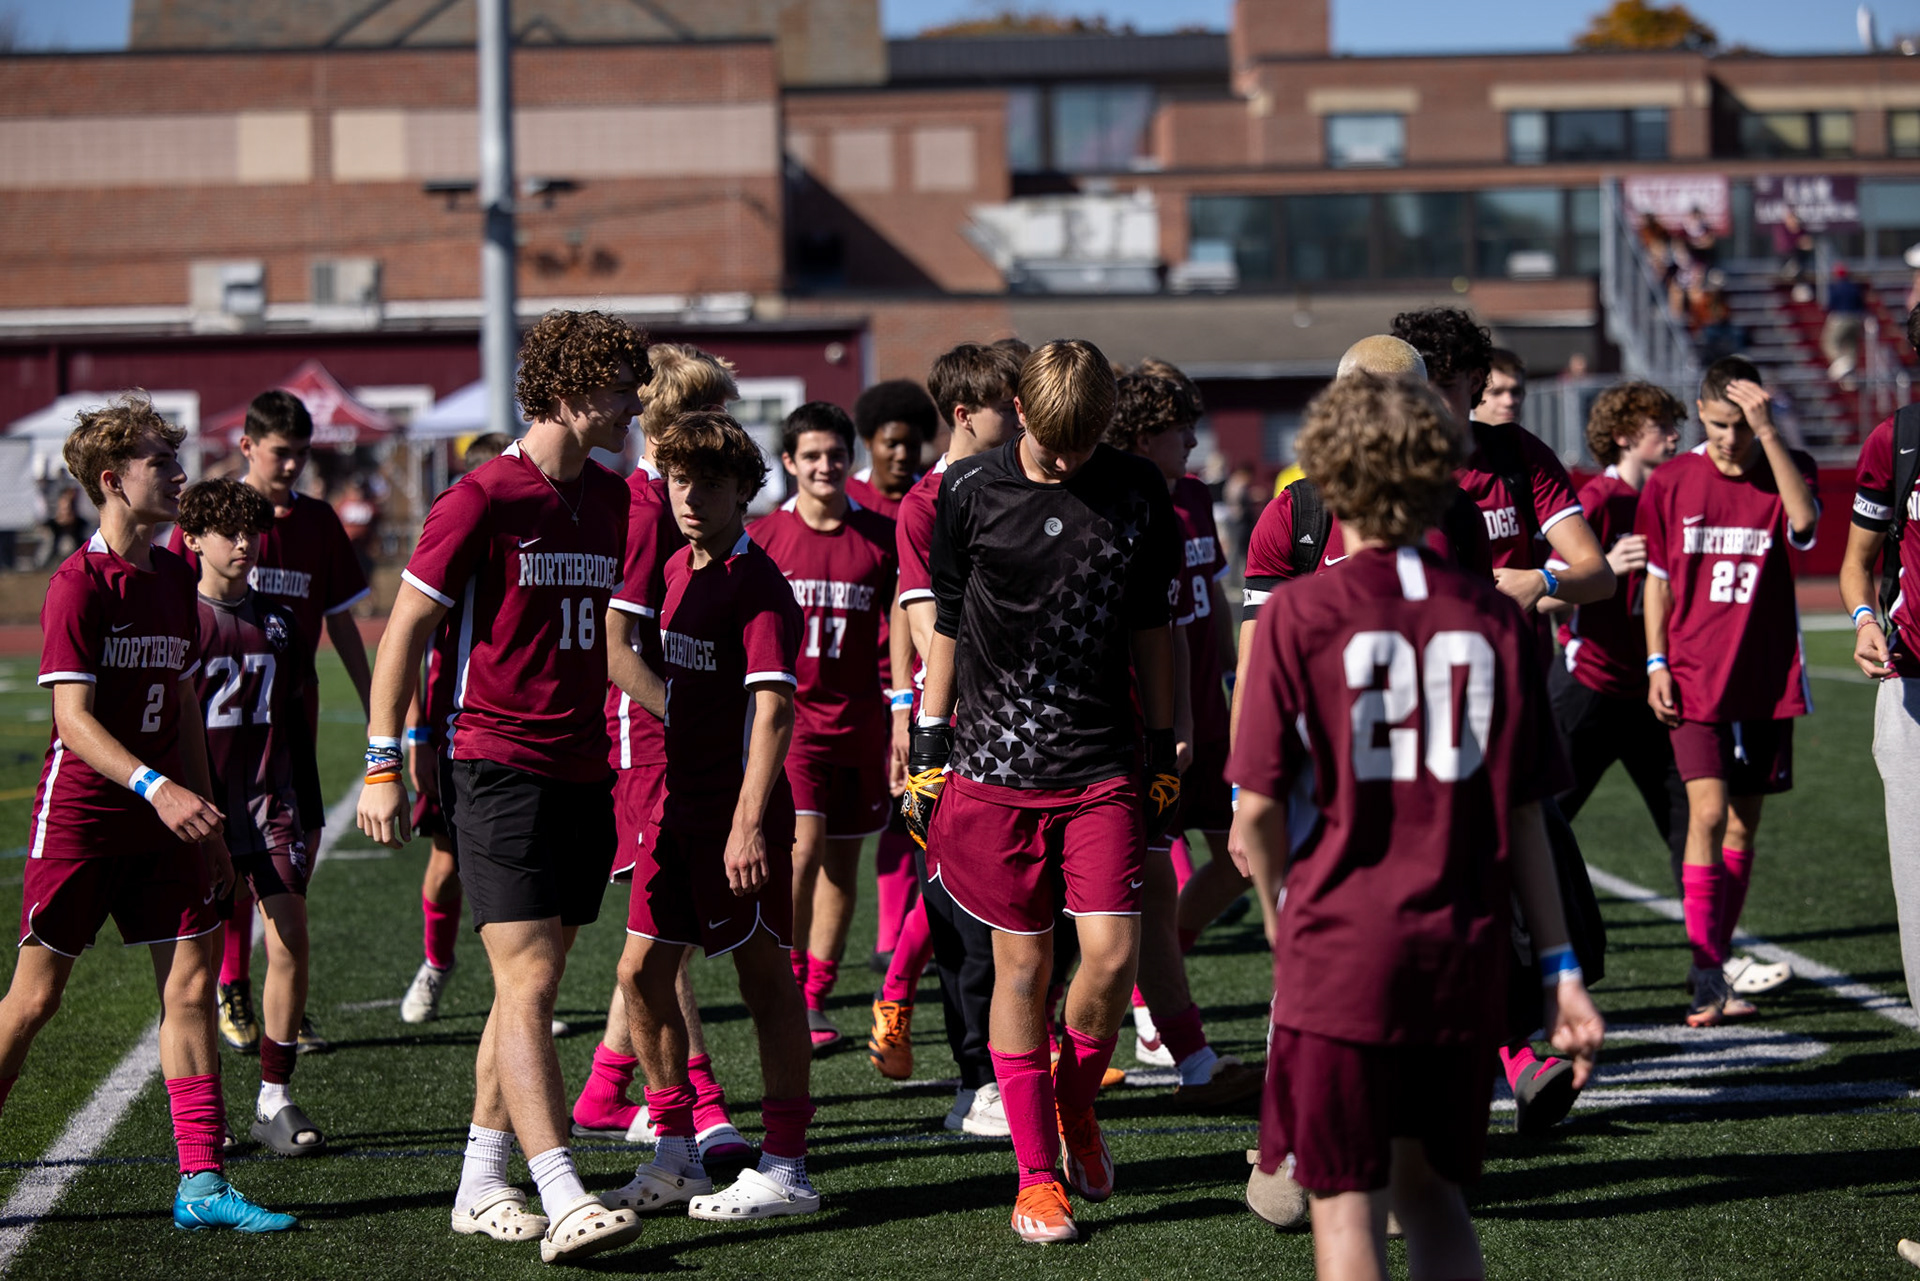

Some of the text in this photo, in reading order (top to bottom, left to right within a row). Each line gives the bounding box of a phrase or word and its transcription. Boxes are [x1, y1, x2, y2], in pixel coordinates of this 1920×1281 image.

[1855, 499, 1879, 516] PTAIN
[1192, 575, 1211, 618] 9
[1709, 561, 1759, 604] 23
[559, 597, 596, 650] 18
[806, 616, 847, 659] 17
[140, 683, 165, 733] 2
[205, 653, 277, 730] 27
[1342, 629, 1496, 783] 20
